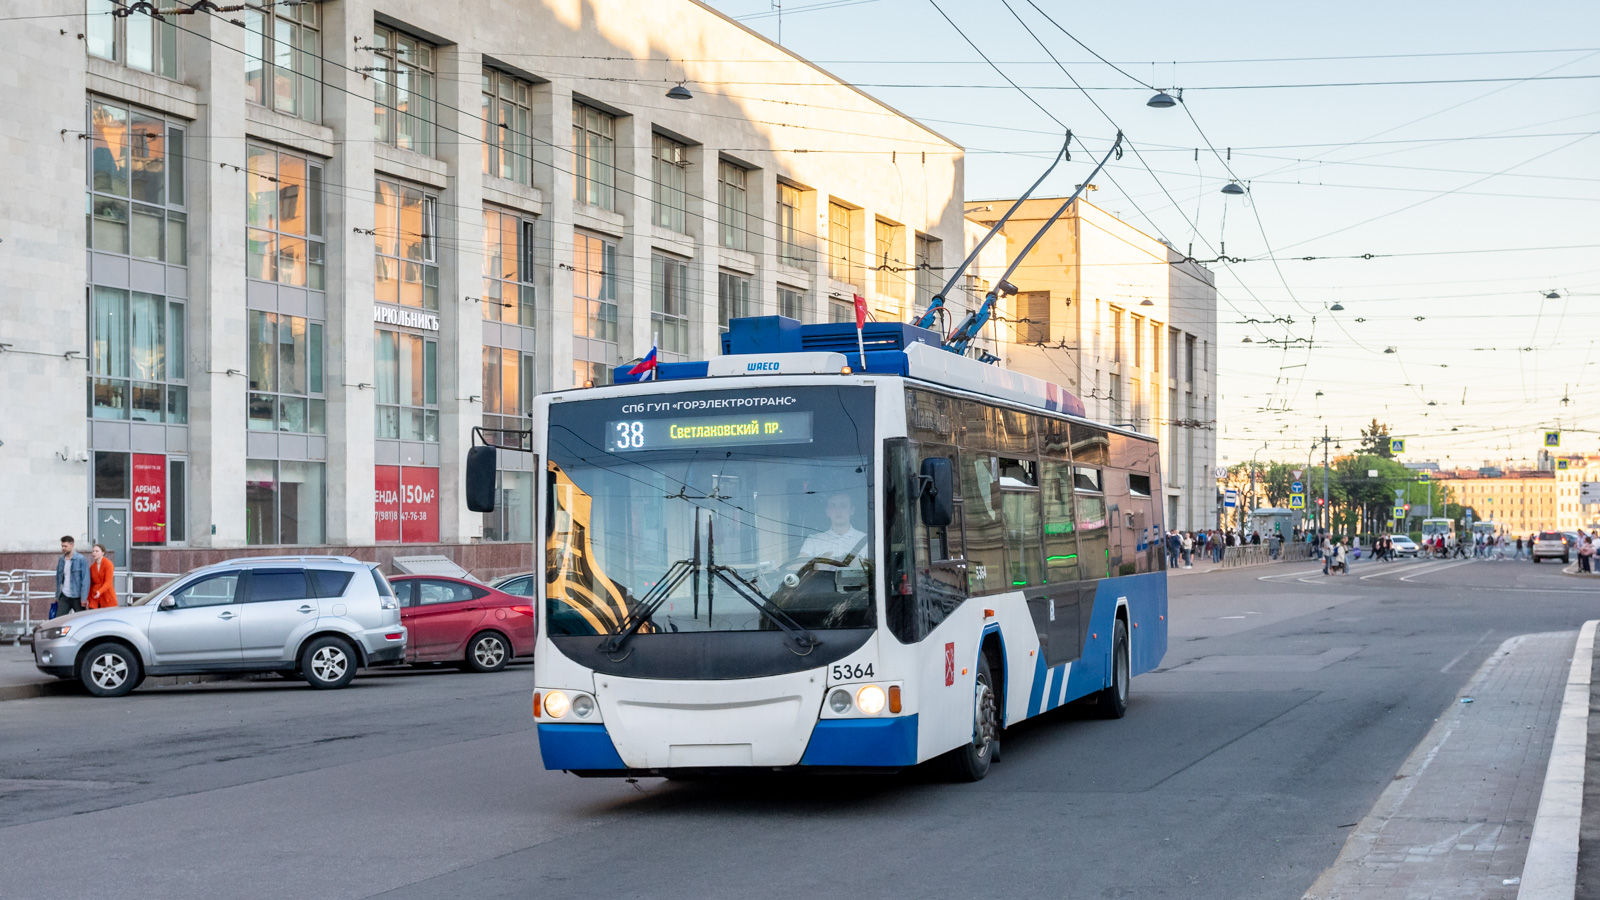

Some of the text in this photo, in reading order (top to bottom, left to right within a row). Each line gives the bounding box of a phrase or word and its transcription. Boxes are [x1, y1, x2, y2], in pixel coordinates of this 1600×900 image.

[747, 362, 780, 371] WAECO
[622, 396, 797, 414] СПб ГУП «ГОРЭЛЕКТРОТРАНС»
[616, 421, 645, 449] 38
[670, 420, 760, 440] Светлановский
[134, 485, 160, 494] АРЕНДА
[832, 663, 874, 680] 5364
